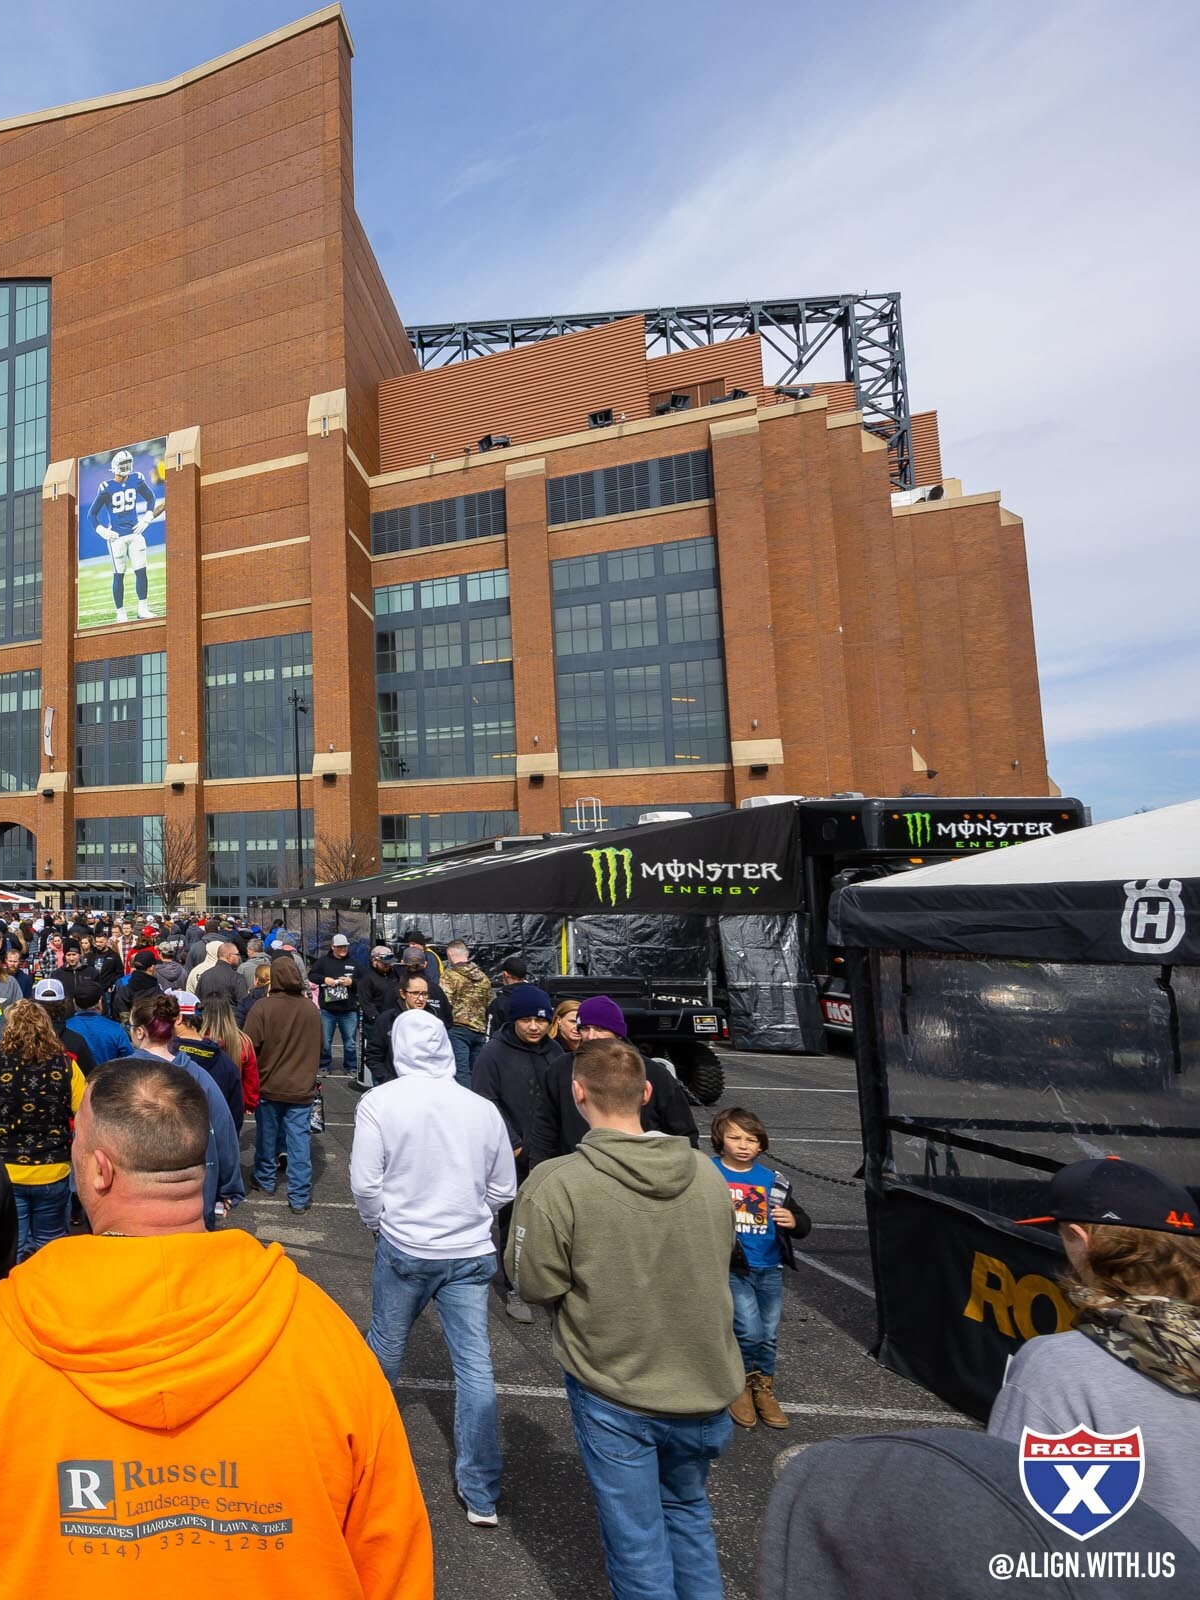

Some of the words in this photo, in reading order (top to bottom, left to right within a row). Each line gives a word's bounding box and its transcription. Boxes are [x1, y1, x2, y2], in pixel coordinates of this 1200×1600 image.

[111, 487, 137, 514] 99
[936, 820, 1057, 839] MONSTER
[640, 859, 783, 882] MONSTER
[664, 885, 760, 895] ENERGY
[1165, 1209, 1195, 1230] 44
[121, 1460, 240, 1492] Russell
[65, 1468, 108, 1510] R
[126, 1493, 211, 1518] Landscape
[216, 1497, 283, 1516] Services
[64, 1523, 134, 1538] LANDSCAPES
[142, 1516, 207, 1536] HARDSCAPES
[219, 1520, 248, 1532] LAWN
[250, 1523, 259, 1533] &
[262, 1522, 288, 1534] TREE
[67, 1540, 141, 1560] (614)
[159, 1531, 286, 1552] 332-1236
